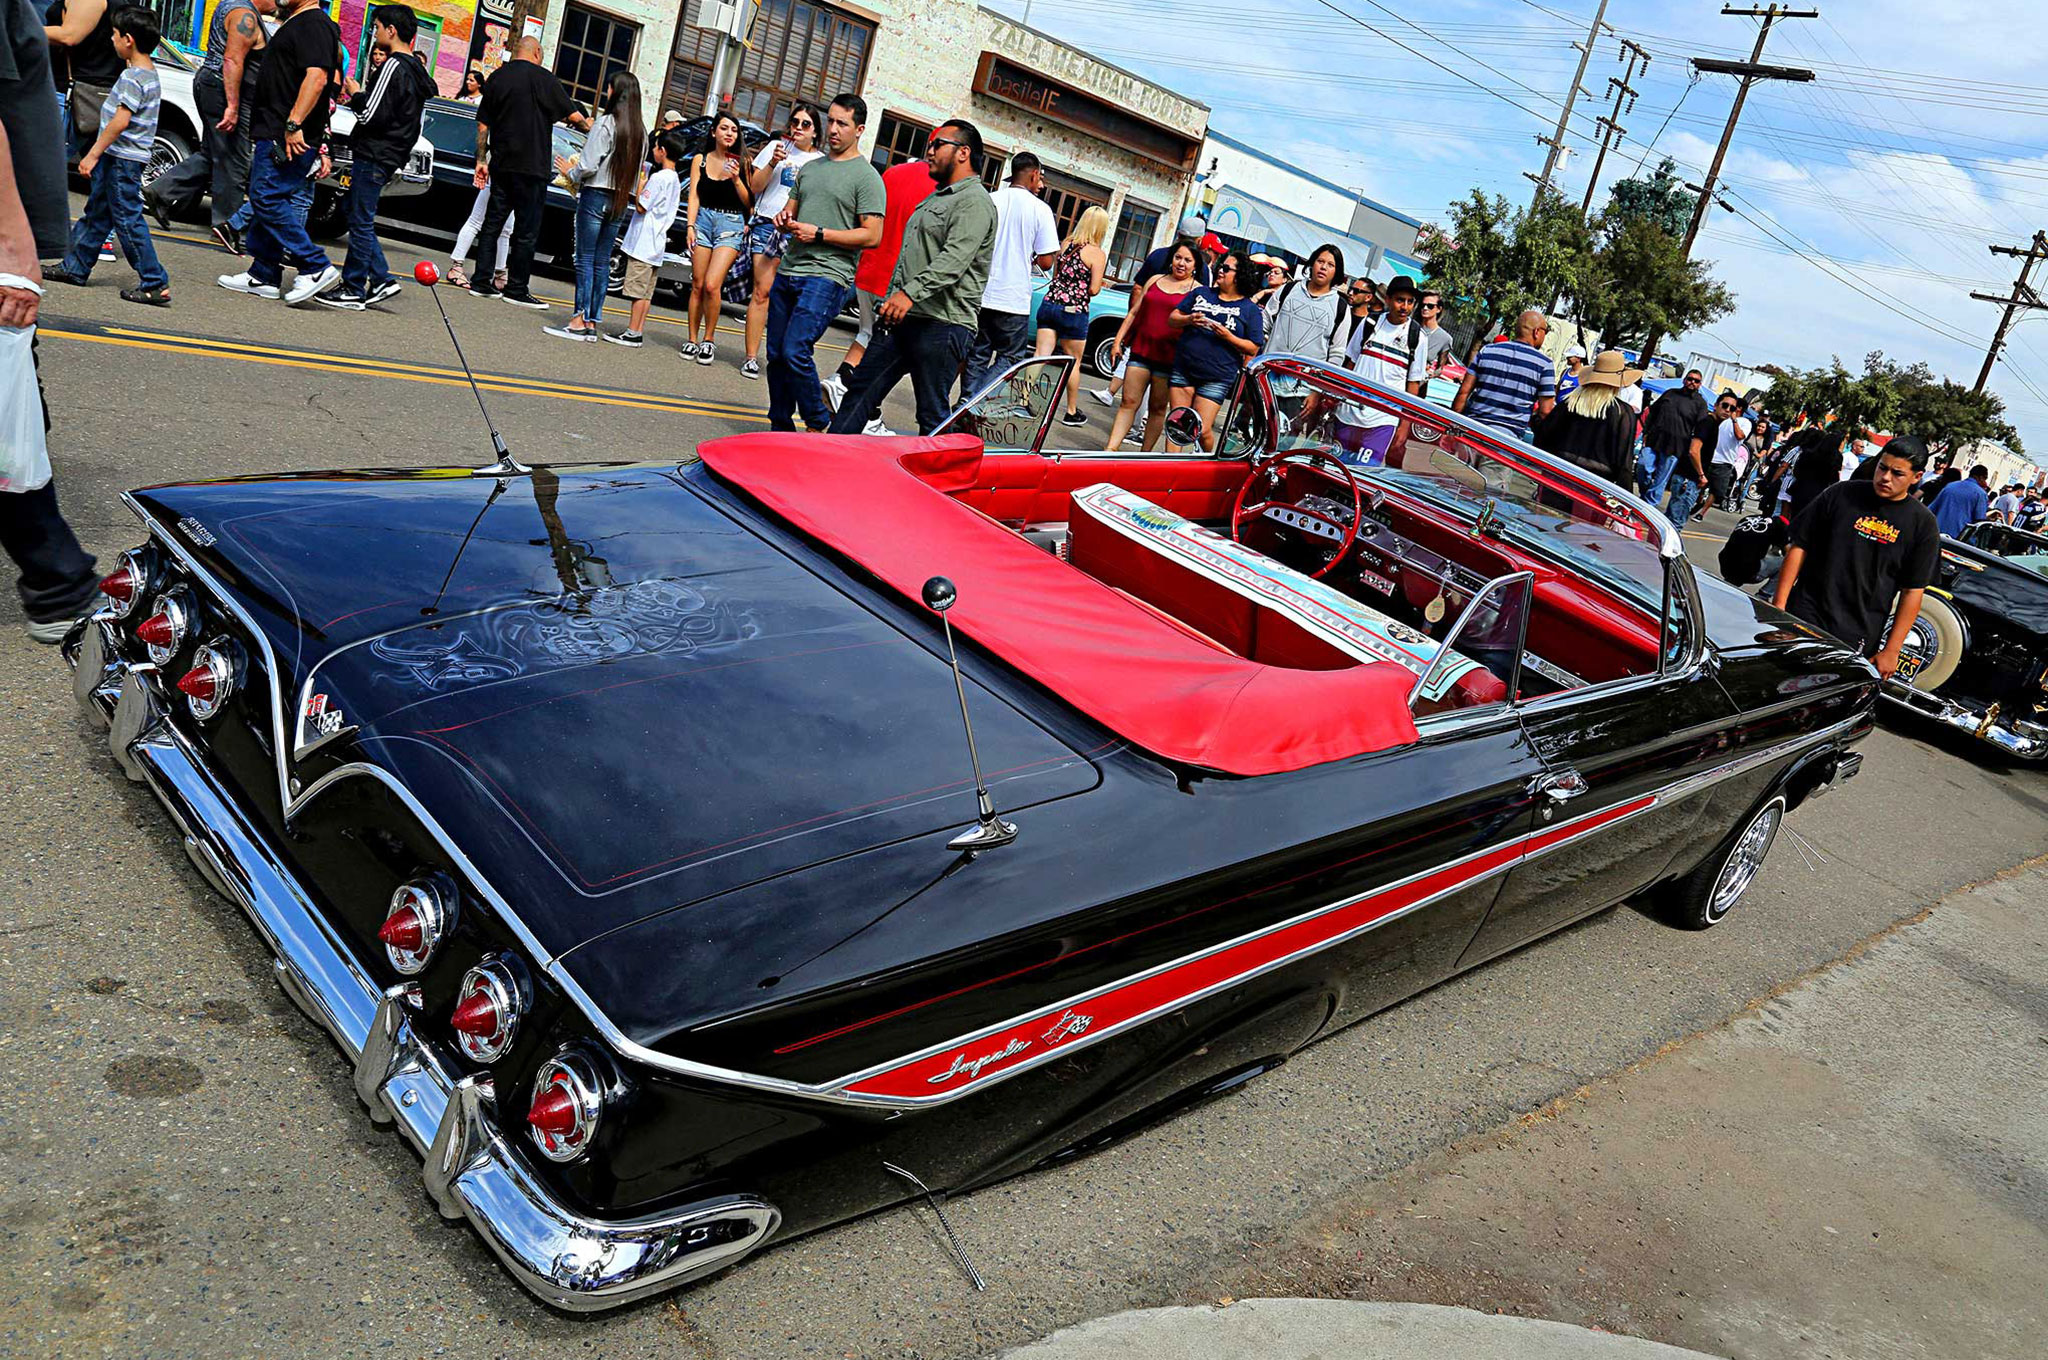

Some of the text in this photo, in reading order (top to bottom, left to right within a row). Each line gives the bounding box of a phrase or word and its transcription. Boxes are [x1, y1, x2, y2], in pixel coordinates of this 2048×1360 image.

[1049, 44, 1134, 101] MEXICAN
[1139, 83, 1194, 126] FOODS
[1191, 295, 1241, 317] Dodgers
[1356, 446, 1374, 464] 18
[926, 1038, 1033, 1084] Impala
